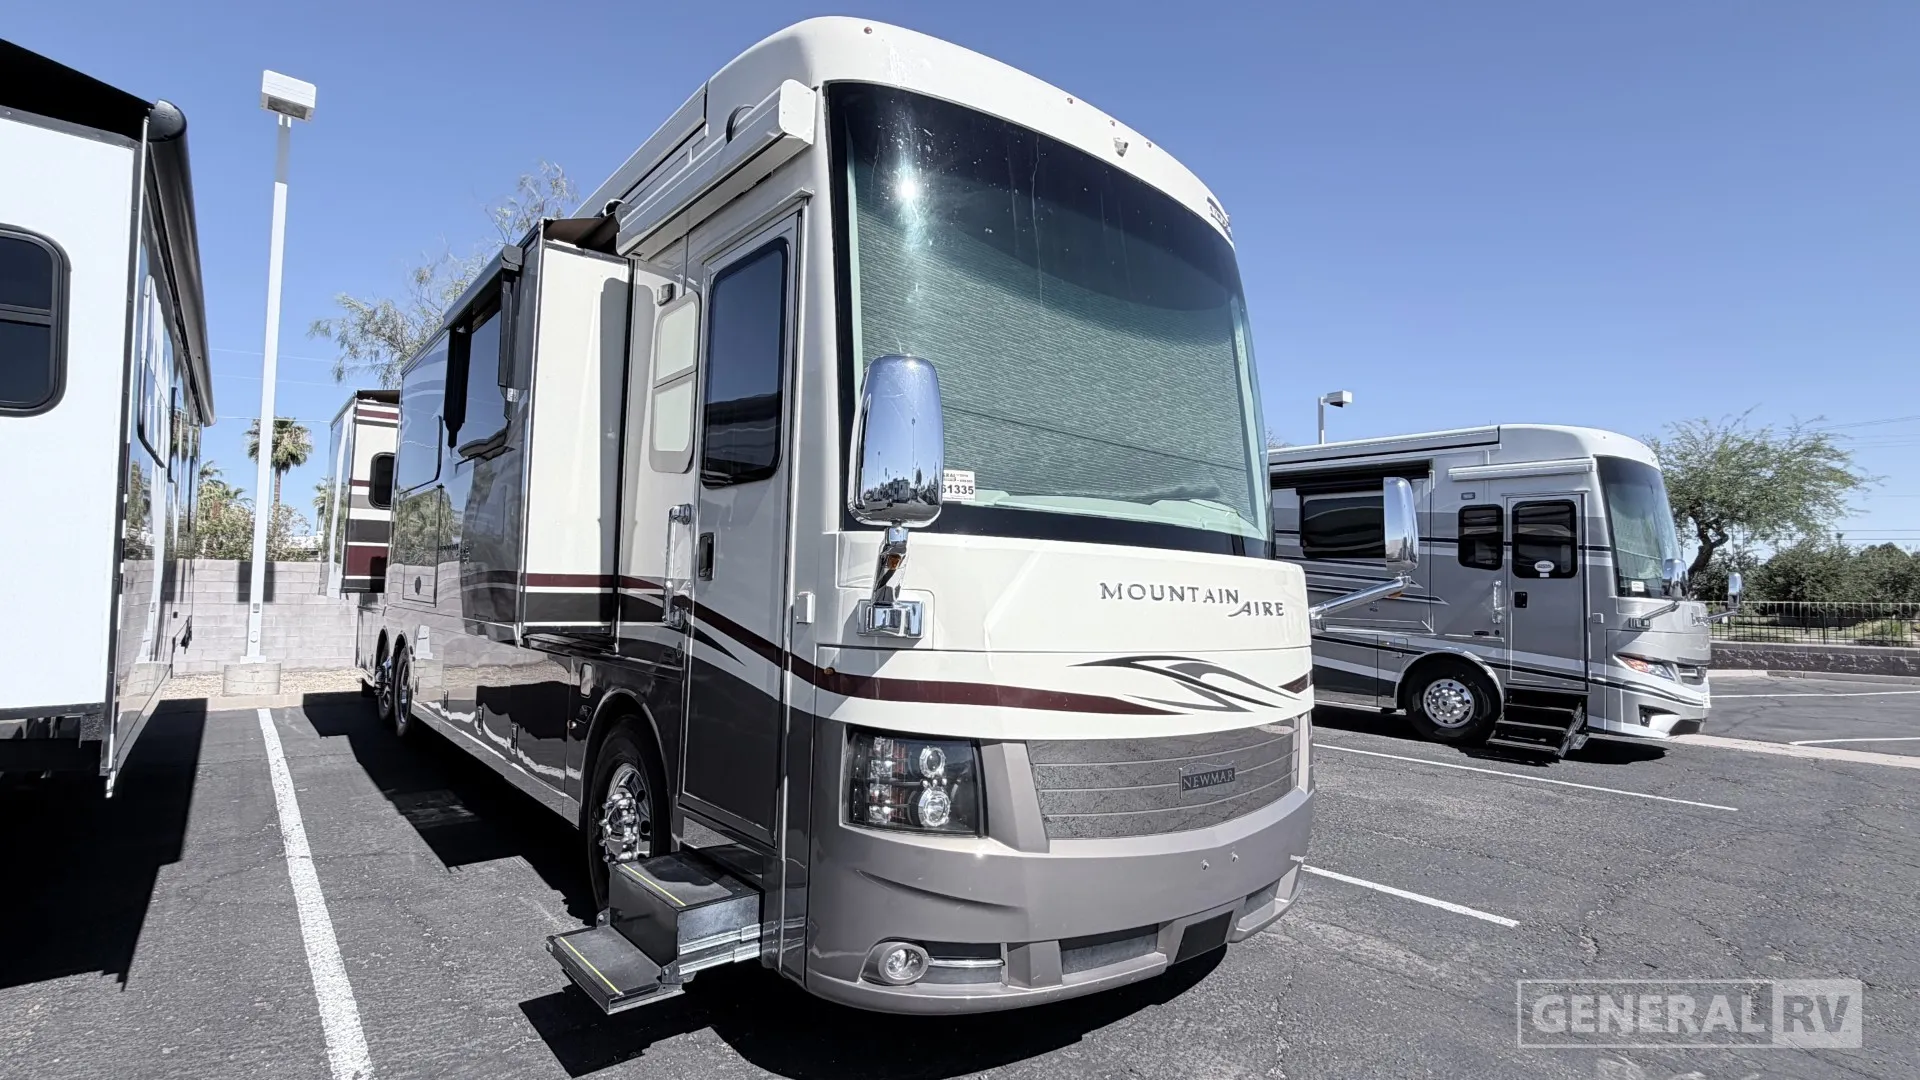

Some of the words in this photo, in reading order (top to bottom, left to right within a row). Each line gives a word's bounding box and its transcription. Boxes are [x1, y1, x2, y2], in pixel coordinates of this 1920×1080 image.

[1099, 582, 1239, 604] MOUNTAIN
[1227, 601, 1285, 617] AIRE
[1183, 769, 1234, 790] NEWMAR
